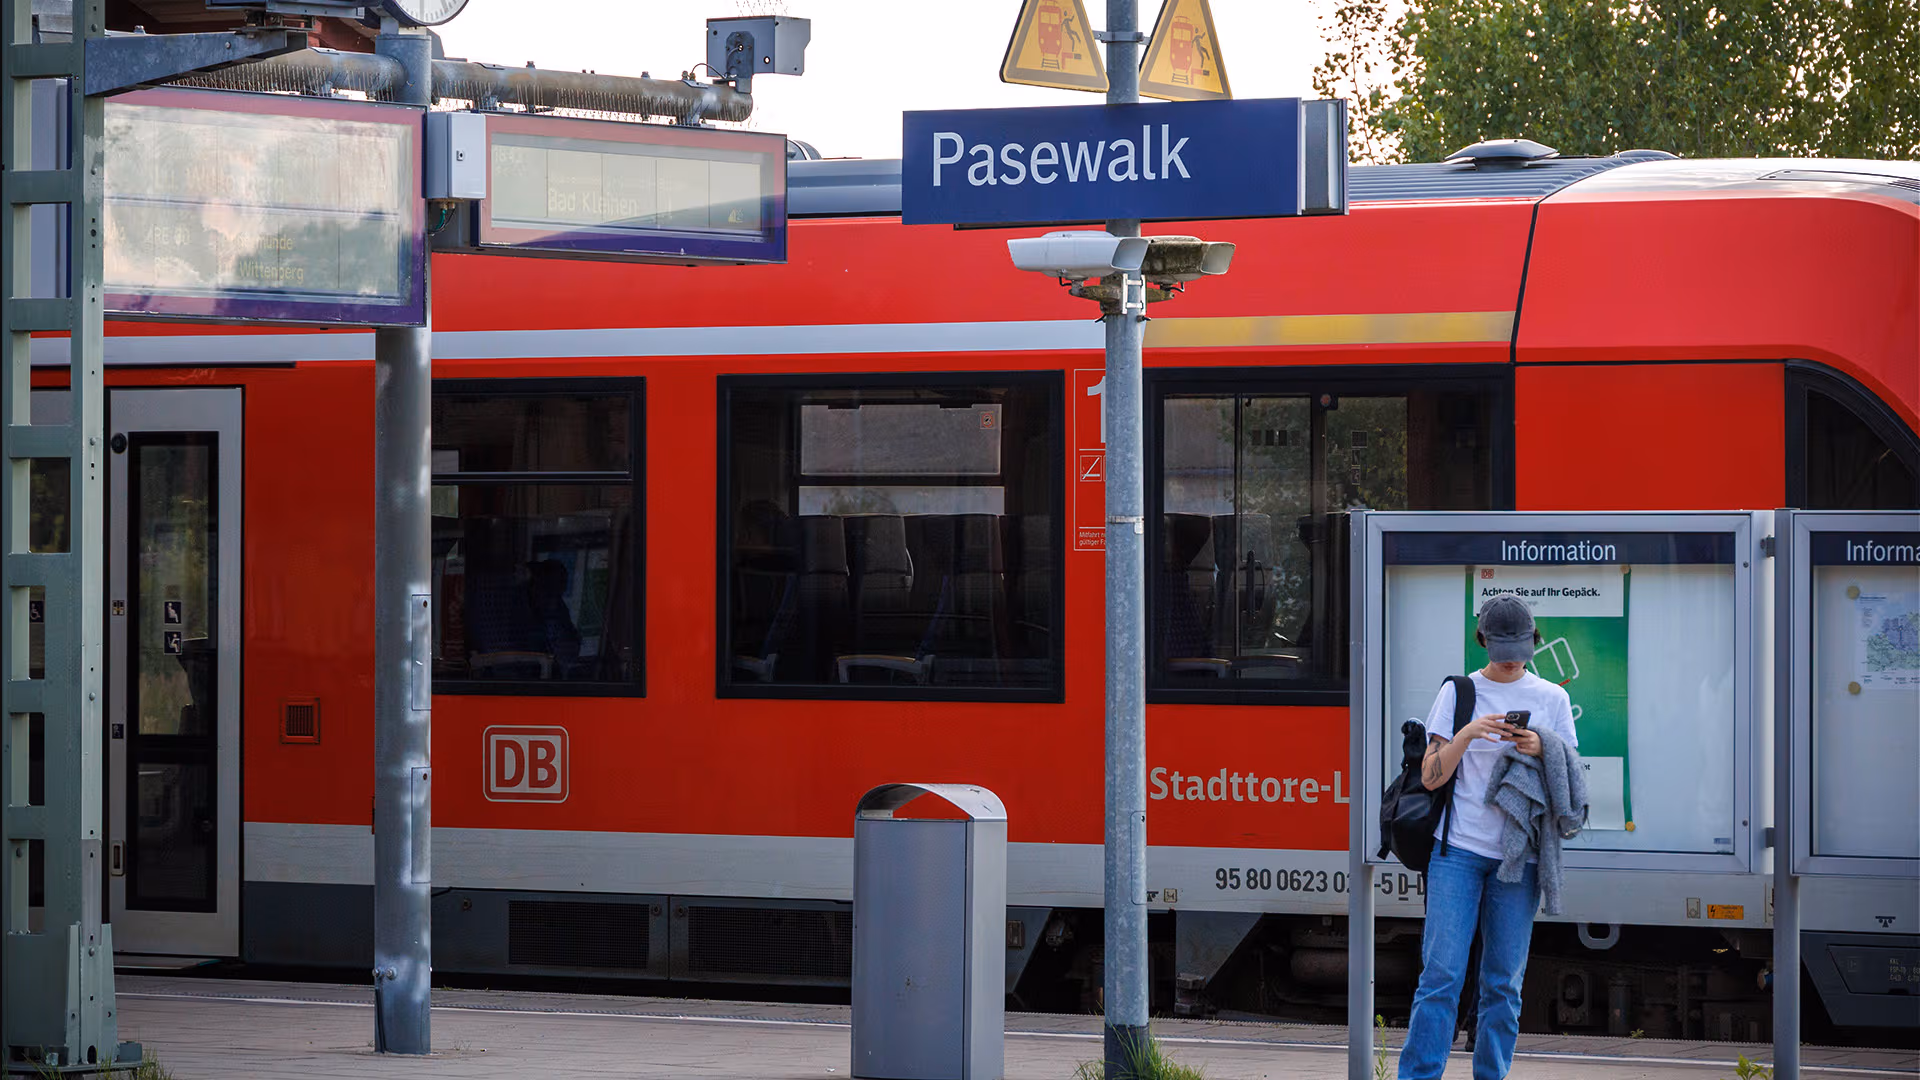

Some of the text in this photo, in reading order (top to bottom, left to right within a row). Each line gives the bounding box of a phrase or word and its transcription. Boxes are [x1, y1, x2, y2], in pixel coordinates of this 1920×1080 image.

[932, 124, 1191, 187] Pasewalk
[549, 189, 638, 216] Bad Kleinen
[239, 260, 305, 284] Wittenberg
[1502, 540, 1616, 561] Information
[1515, 588, 1529, 596] Sie
[1531, 588, 1546, 596] auf
[1548, 588, 1561, 596] Ihr
[1562, 587, 1601, 598] Gepäck.
[495, 739, 558, 788] DB
[1216, 867, 1242, 891] 95
[1246, 868, 1273, 891] 80
[1276, 869, 1329, 893] 0623
